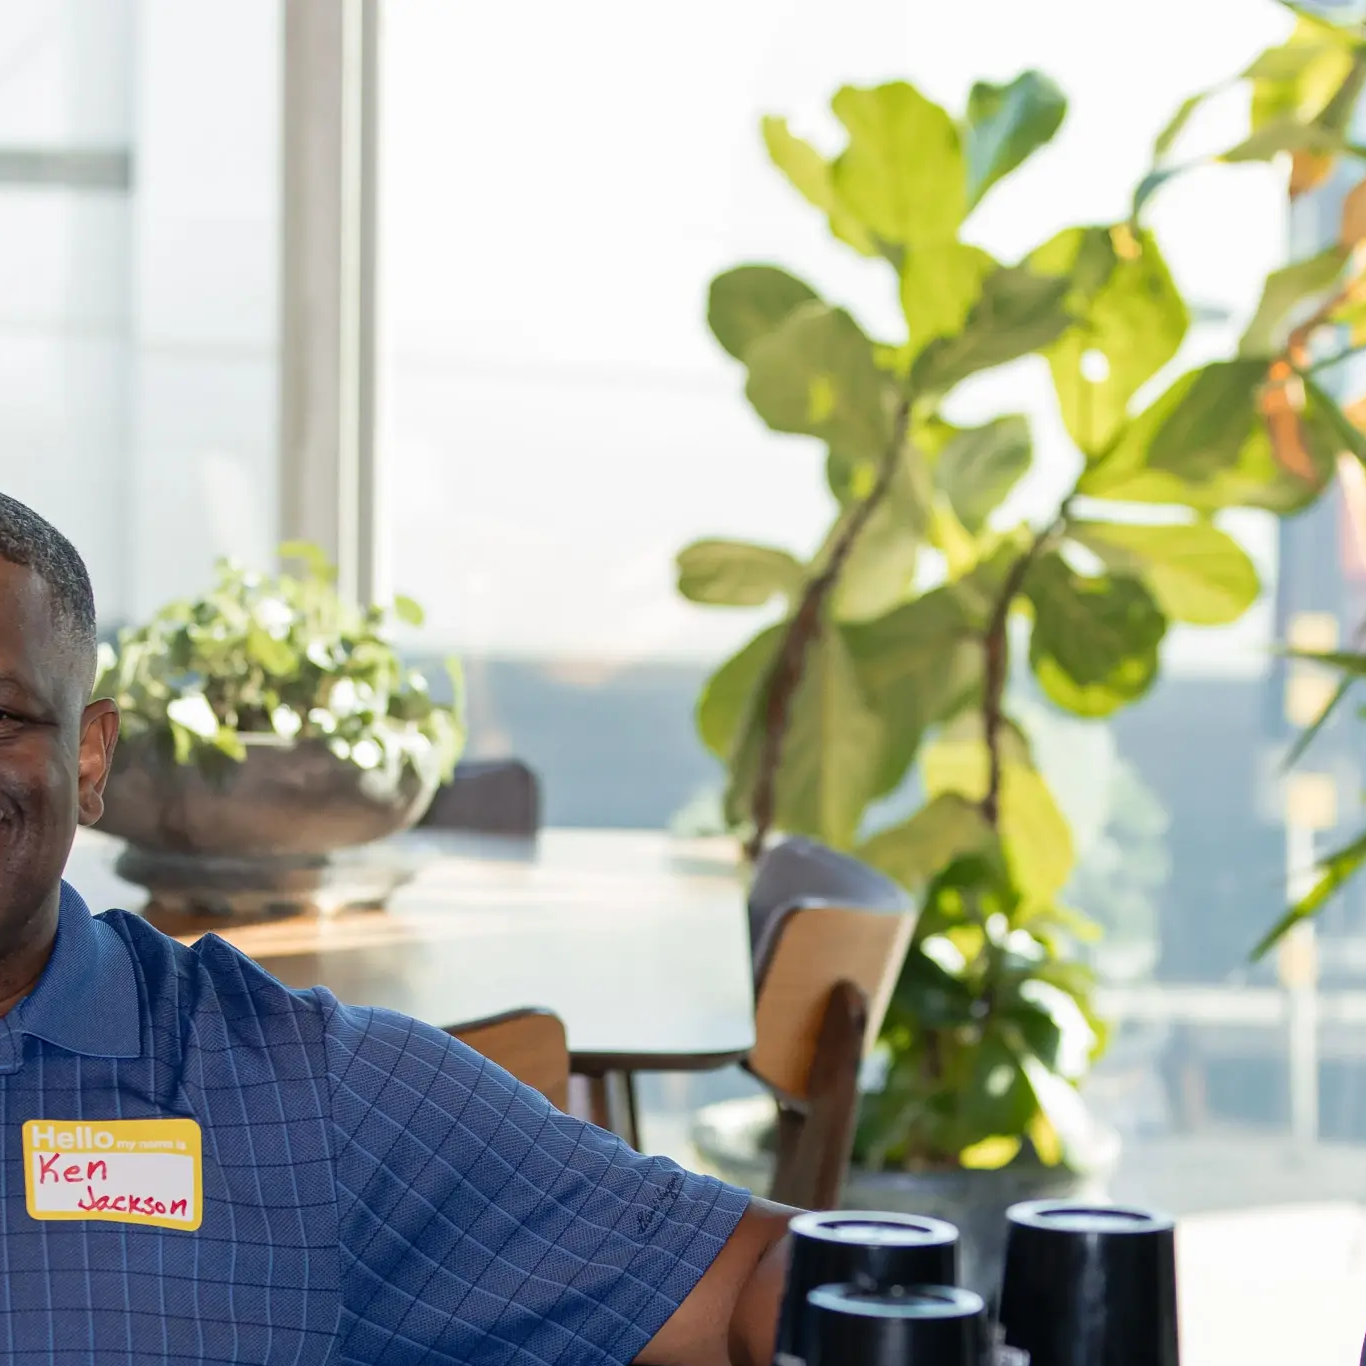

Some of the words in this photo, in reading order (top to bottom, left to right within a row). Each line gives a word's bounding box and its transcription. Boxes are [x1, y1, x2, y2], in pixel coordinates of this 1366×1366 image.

[32, 1125, 115, 1149] Hello
[117, 1140, 136, 1151] my
[139, 1140, 173, 1149] name
[176, 1138, 187, 1150] is
[39, 1153, 107, 1184] Ken
[78, 1186, 187, 1216] Jackson
